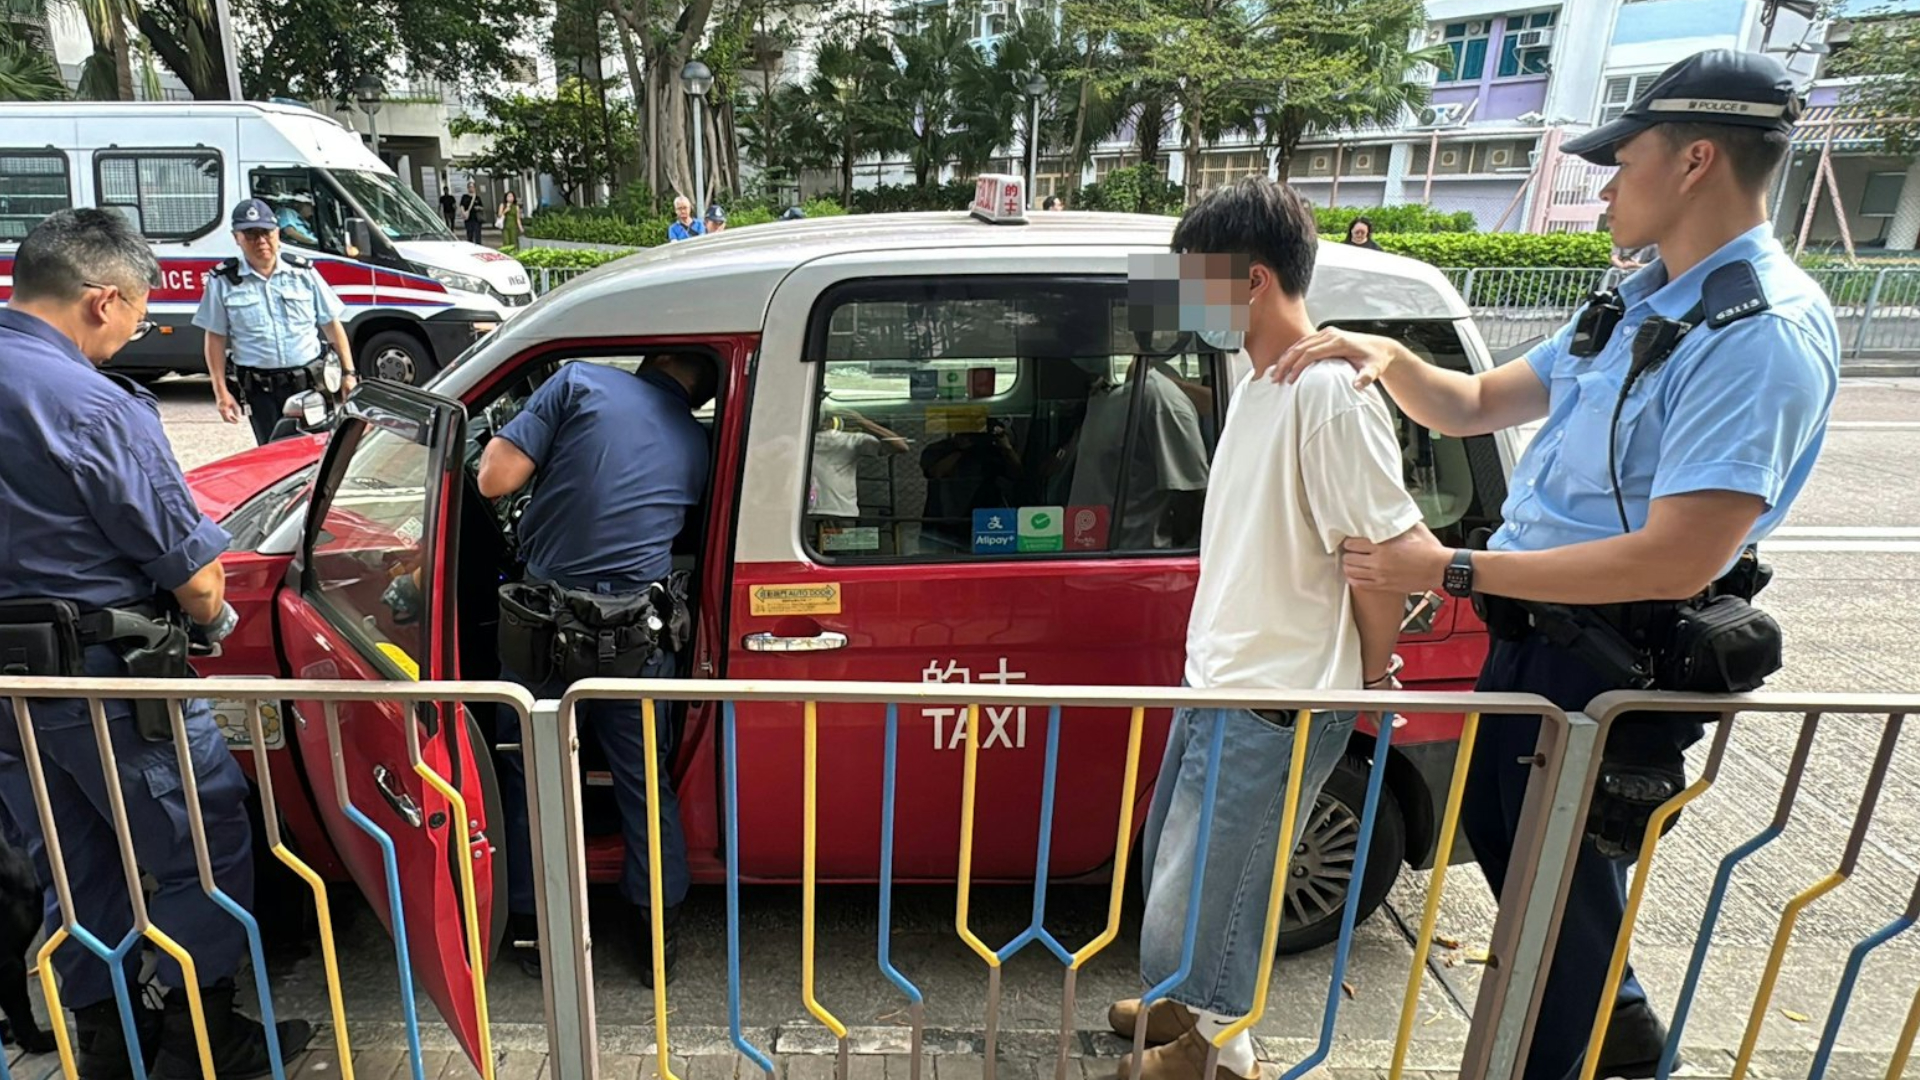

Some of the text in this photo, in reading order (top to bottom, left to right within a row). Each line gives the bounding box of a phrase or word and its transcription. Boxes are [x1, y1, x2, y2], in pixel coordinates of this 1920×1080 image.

[1698, 101, 1738, 111] POLICE
[1004, 183, 1018, 216] 的士
[162, 270, 195, 290] ICE
[788, 588, 832, 597] AUTO DOOR
[921, 706, 1027, 750] TAXI
